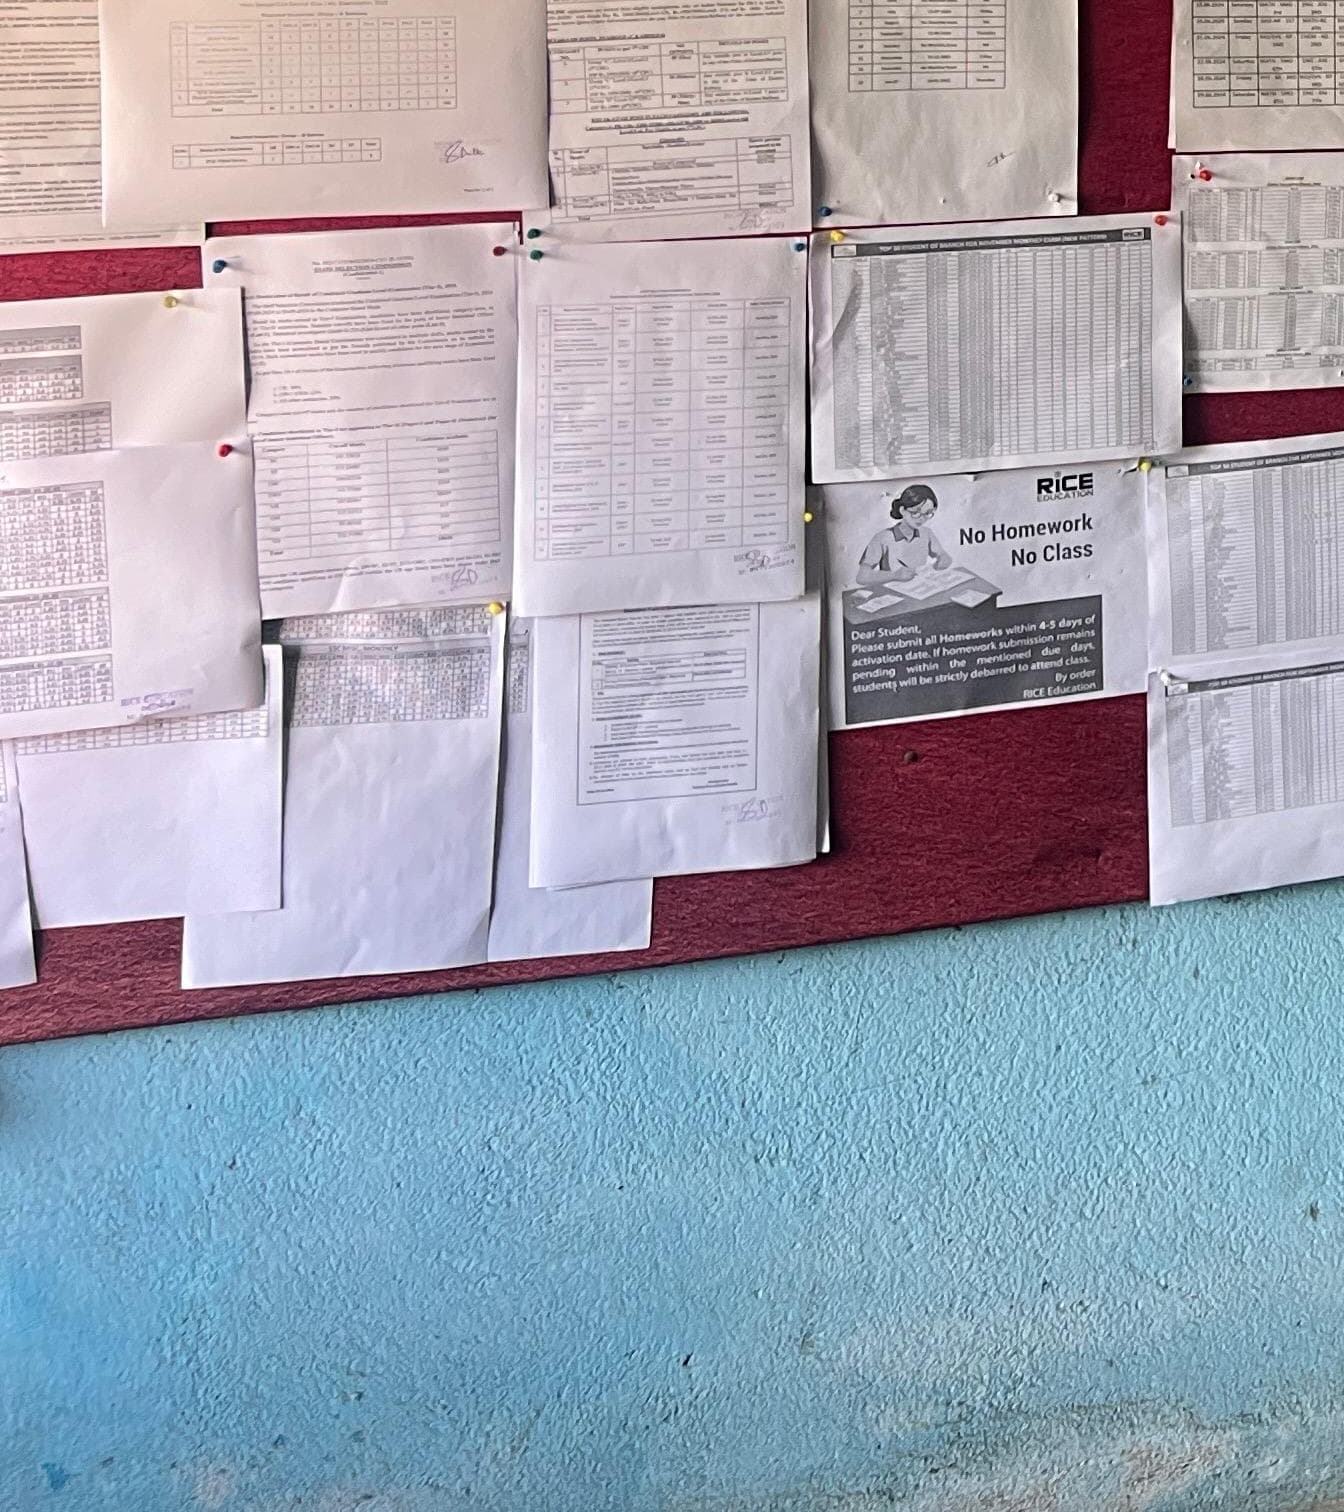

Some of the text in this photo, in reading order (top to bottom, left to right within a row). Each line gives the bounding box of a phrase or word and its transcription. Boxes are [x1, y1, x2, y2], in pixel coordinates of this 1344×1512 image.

[1037, 490, 1093, 502] EDUCATION
[960, 512, 1093, 545] No Homework
[1011, 542, 1093, 567] No Class
[1069, 668, 1096, 679] order
[1048, 681, 1096, 697] Education
